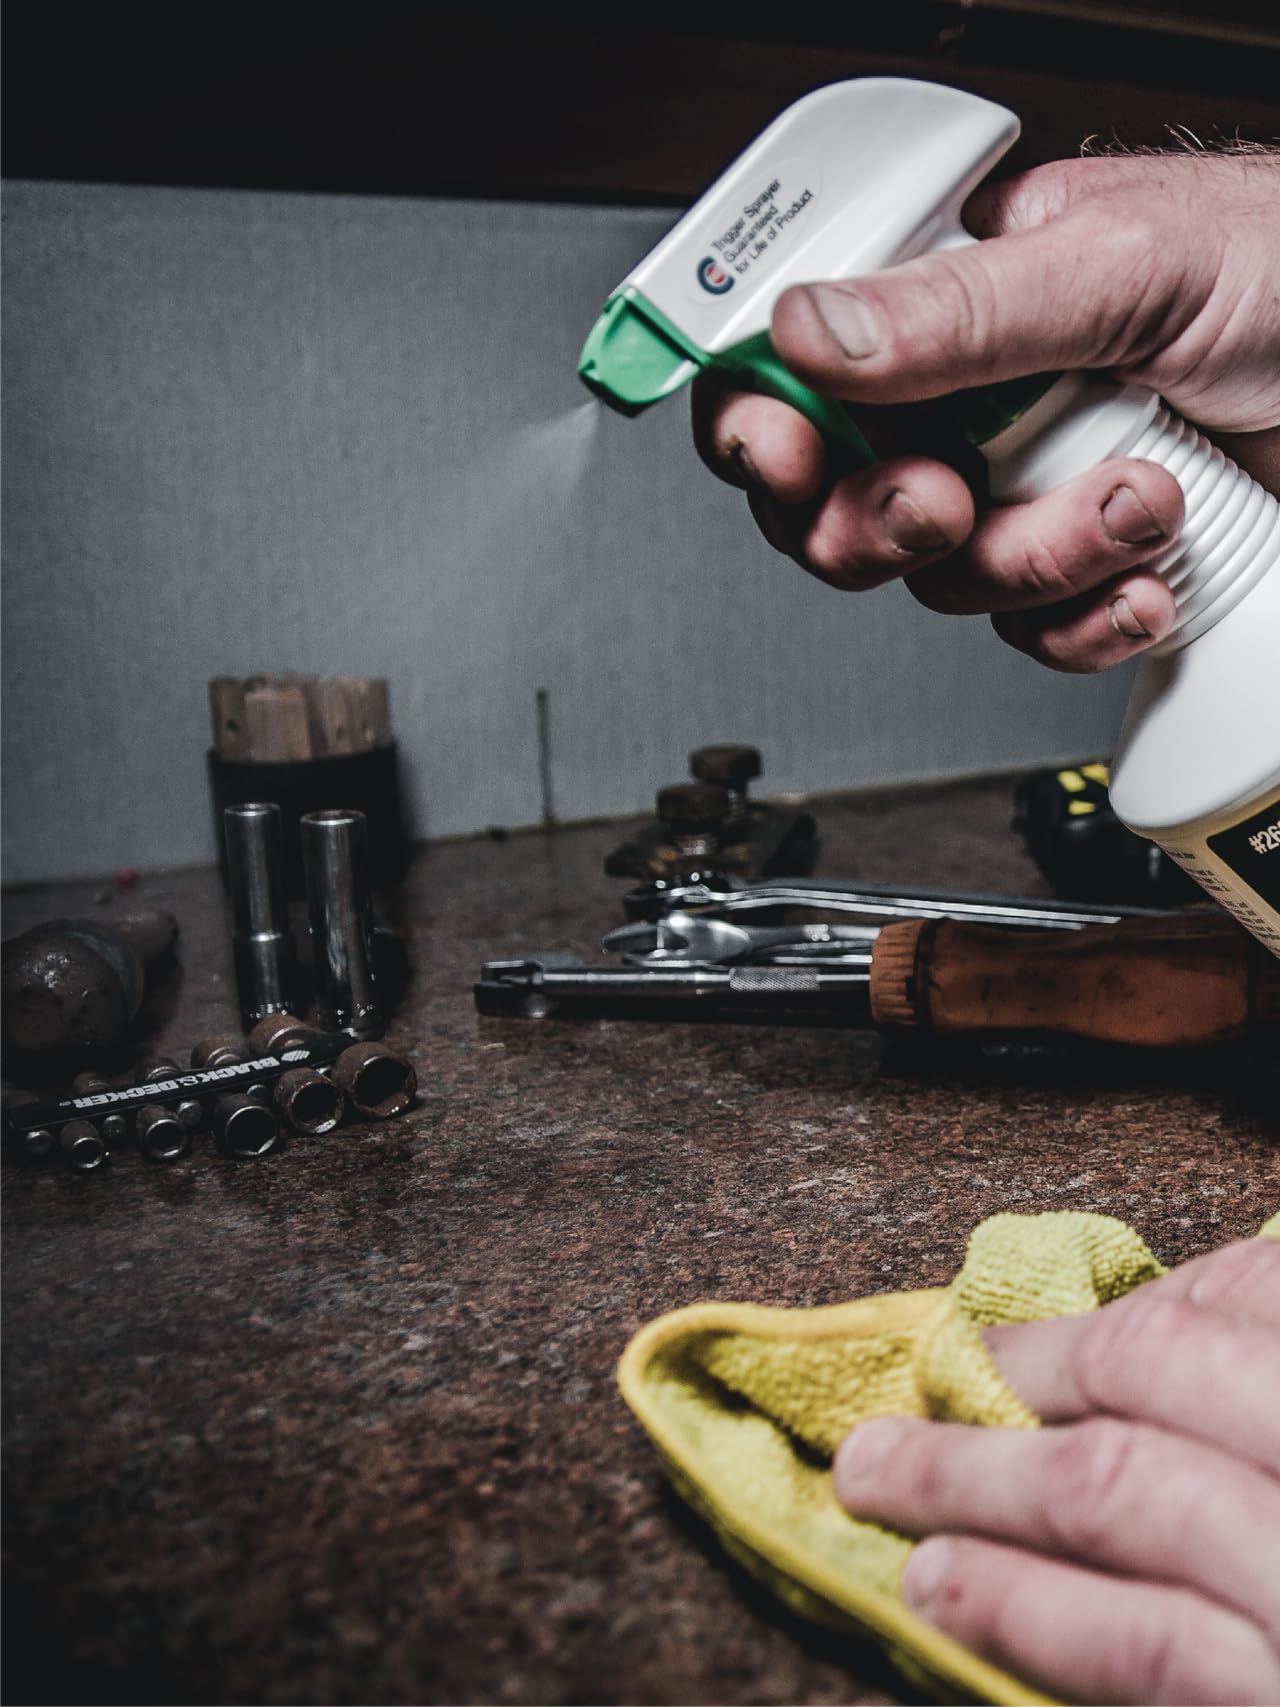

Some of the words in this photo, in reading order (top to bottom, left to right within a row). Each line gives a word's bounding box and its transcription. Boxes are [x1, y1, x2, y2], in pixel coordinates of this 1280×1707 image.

[711, 217, 745, 251] Trigger
[743, 179, 781, 218] Sprayer
[723, 205, 778, 262] Guaranteed
[735, 259, 750, 274] for
[748, 239, 768, 260] Life
[767, 226, 778, 240] of
[774, 188, 814, 229] Product
[72, 1056, 281, 1108] BLACK&DECKER
